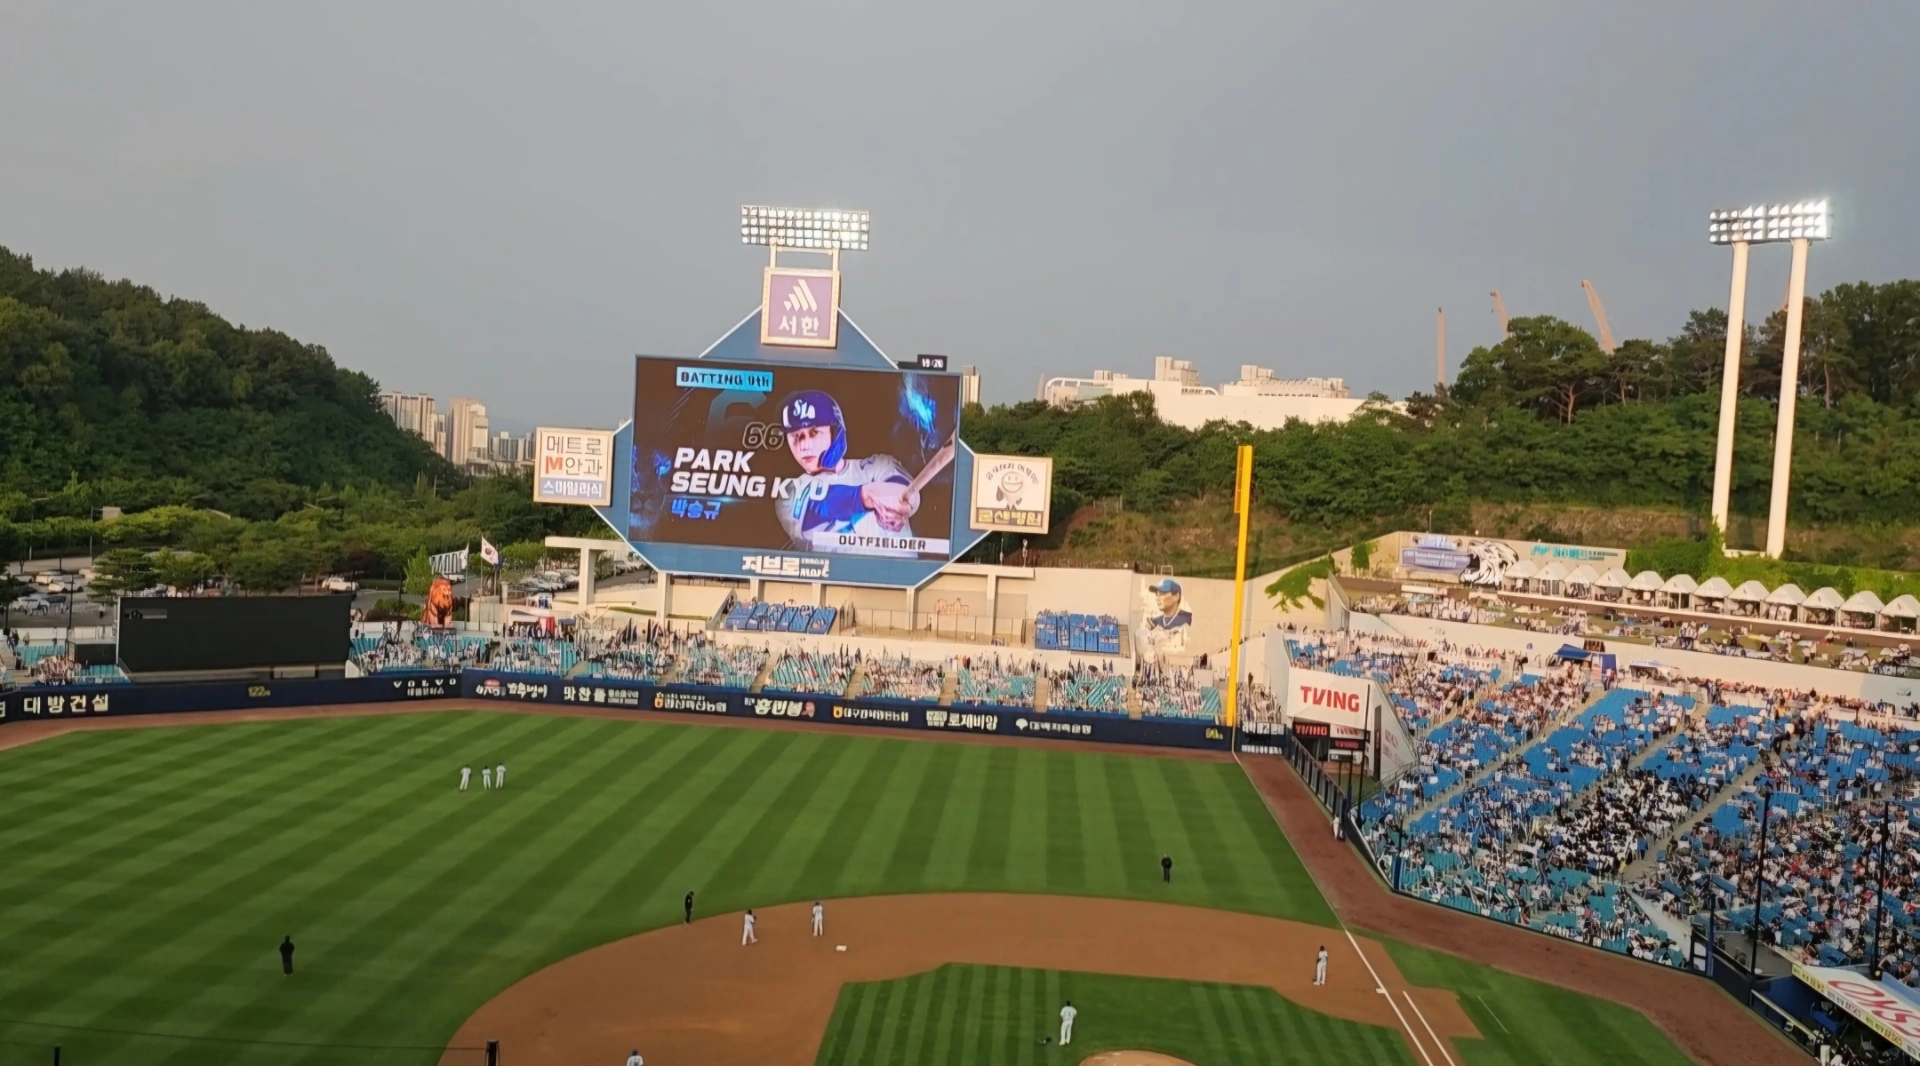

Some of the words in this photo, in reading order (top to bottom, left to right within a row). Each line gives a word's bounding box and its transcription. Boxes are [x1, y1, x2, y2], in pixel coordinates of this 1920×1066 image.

[779, 315, 820, 338] 서한
[681, 371, 743, 386] BATTING
[546, 435, 603, 456] 메트로
[742, 421, 785, 451] 66
[674, 447, 756, 473] PARK
[671, 471, 767, 498] SEUNG
[671, 499, 722, 520] 박승규
[838, 535, 927, 551] OUTFIELDER
[393, 678, 457, 689] VOLVO
[23, 693, 109, 715] 대방건설
[1300, 685, 1360, 713] TVING
[947, 712, 998, 731] 로제비앙
